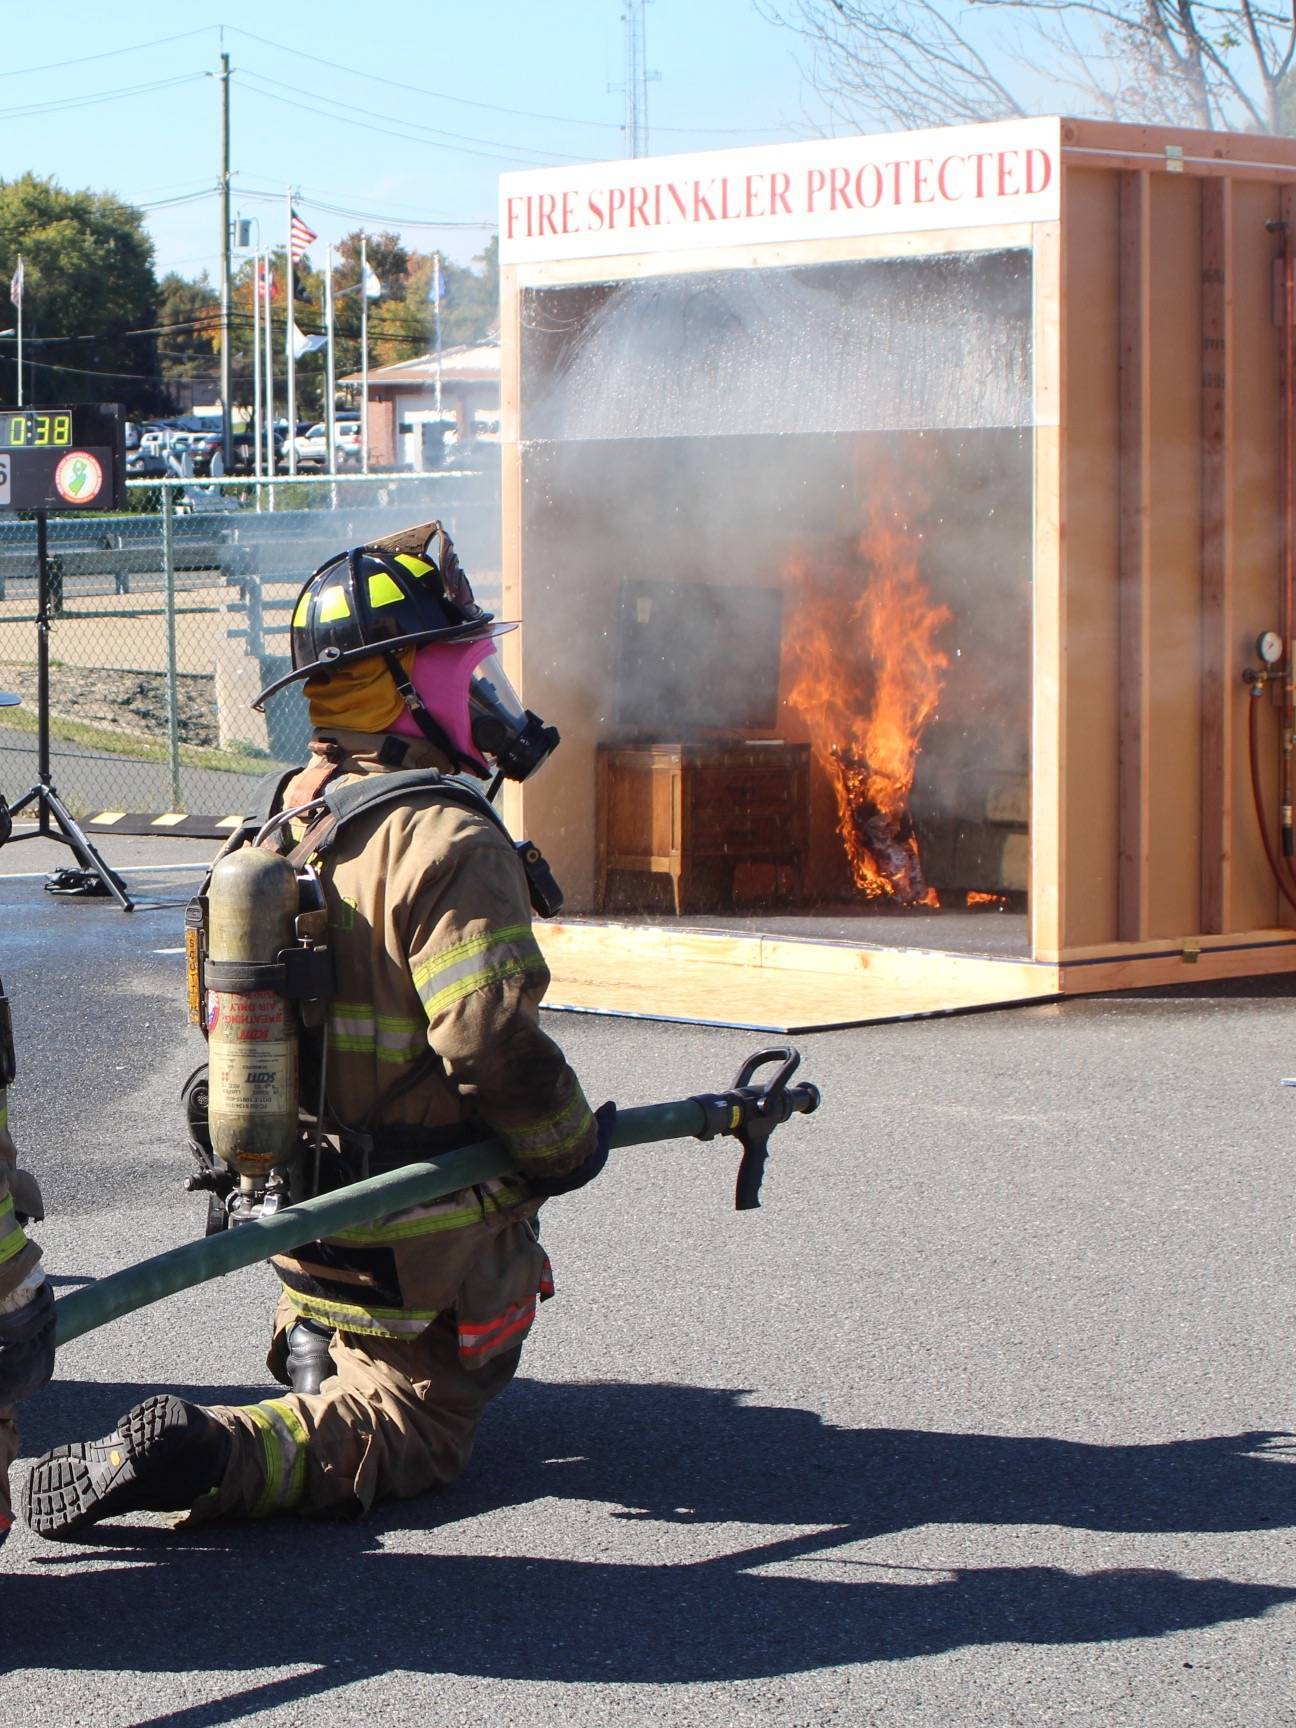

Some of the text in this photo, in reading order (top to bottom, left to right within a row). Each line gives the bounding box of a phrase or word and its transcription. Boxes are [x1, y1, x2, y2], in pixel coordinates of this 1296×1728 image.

[506, 148, 1052, 239] FIRE SPRINKLER PROTECTED
[10, 416, 69, 445] 0:38
